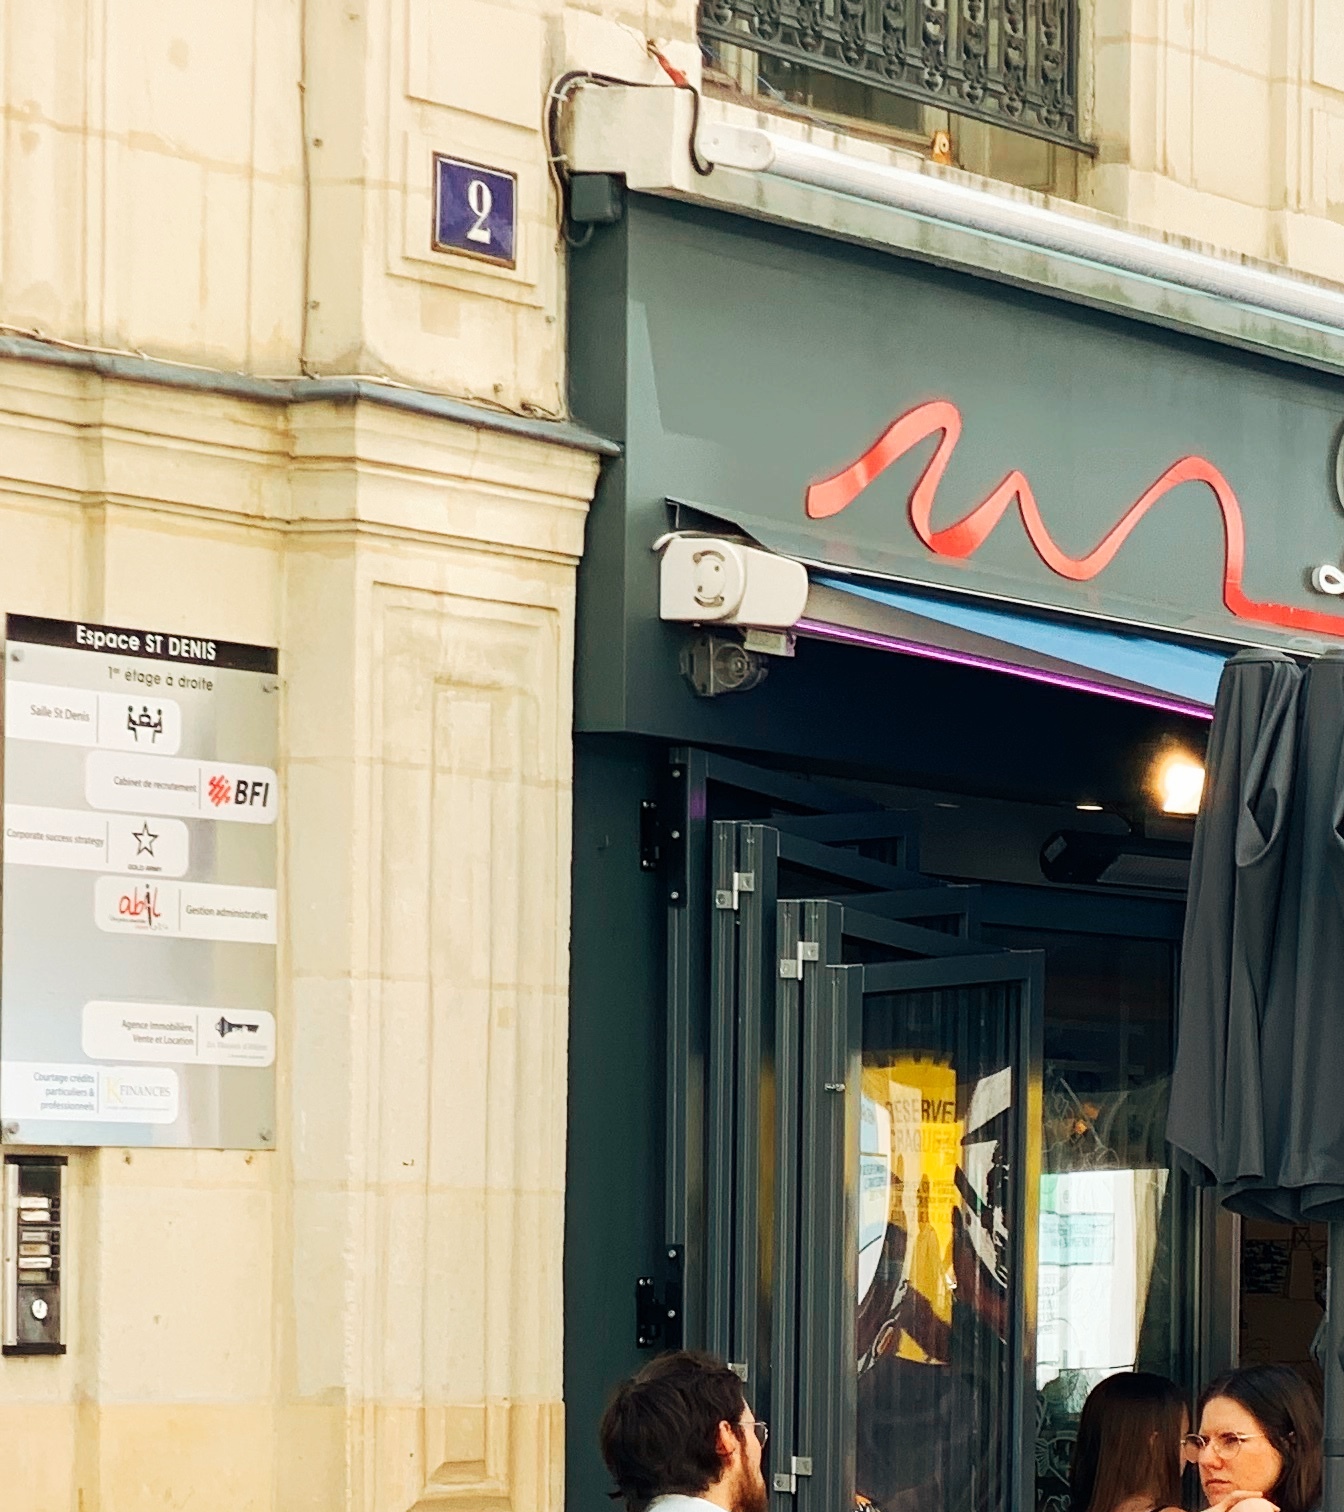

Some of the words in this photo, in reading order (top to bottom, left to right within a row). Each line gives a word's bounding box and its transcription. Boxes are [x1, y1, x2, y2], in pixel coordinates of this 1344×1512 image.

[467, 179, 492, 245] 2
[76, 624, 141, 651] Espace
[145, 635, 163, 654] ST
[168, 637, 217, 661] DENIS
[178, 675, 214, 692] droite
[30, 704, 52, 719] Salle
[64, 709, 91, 723] Denis
[234, 779, 270, 808] BFI
[185, 905, 215, 916] Gestion
